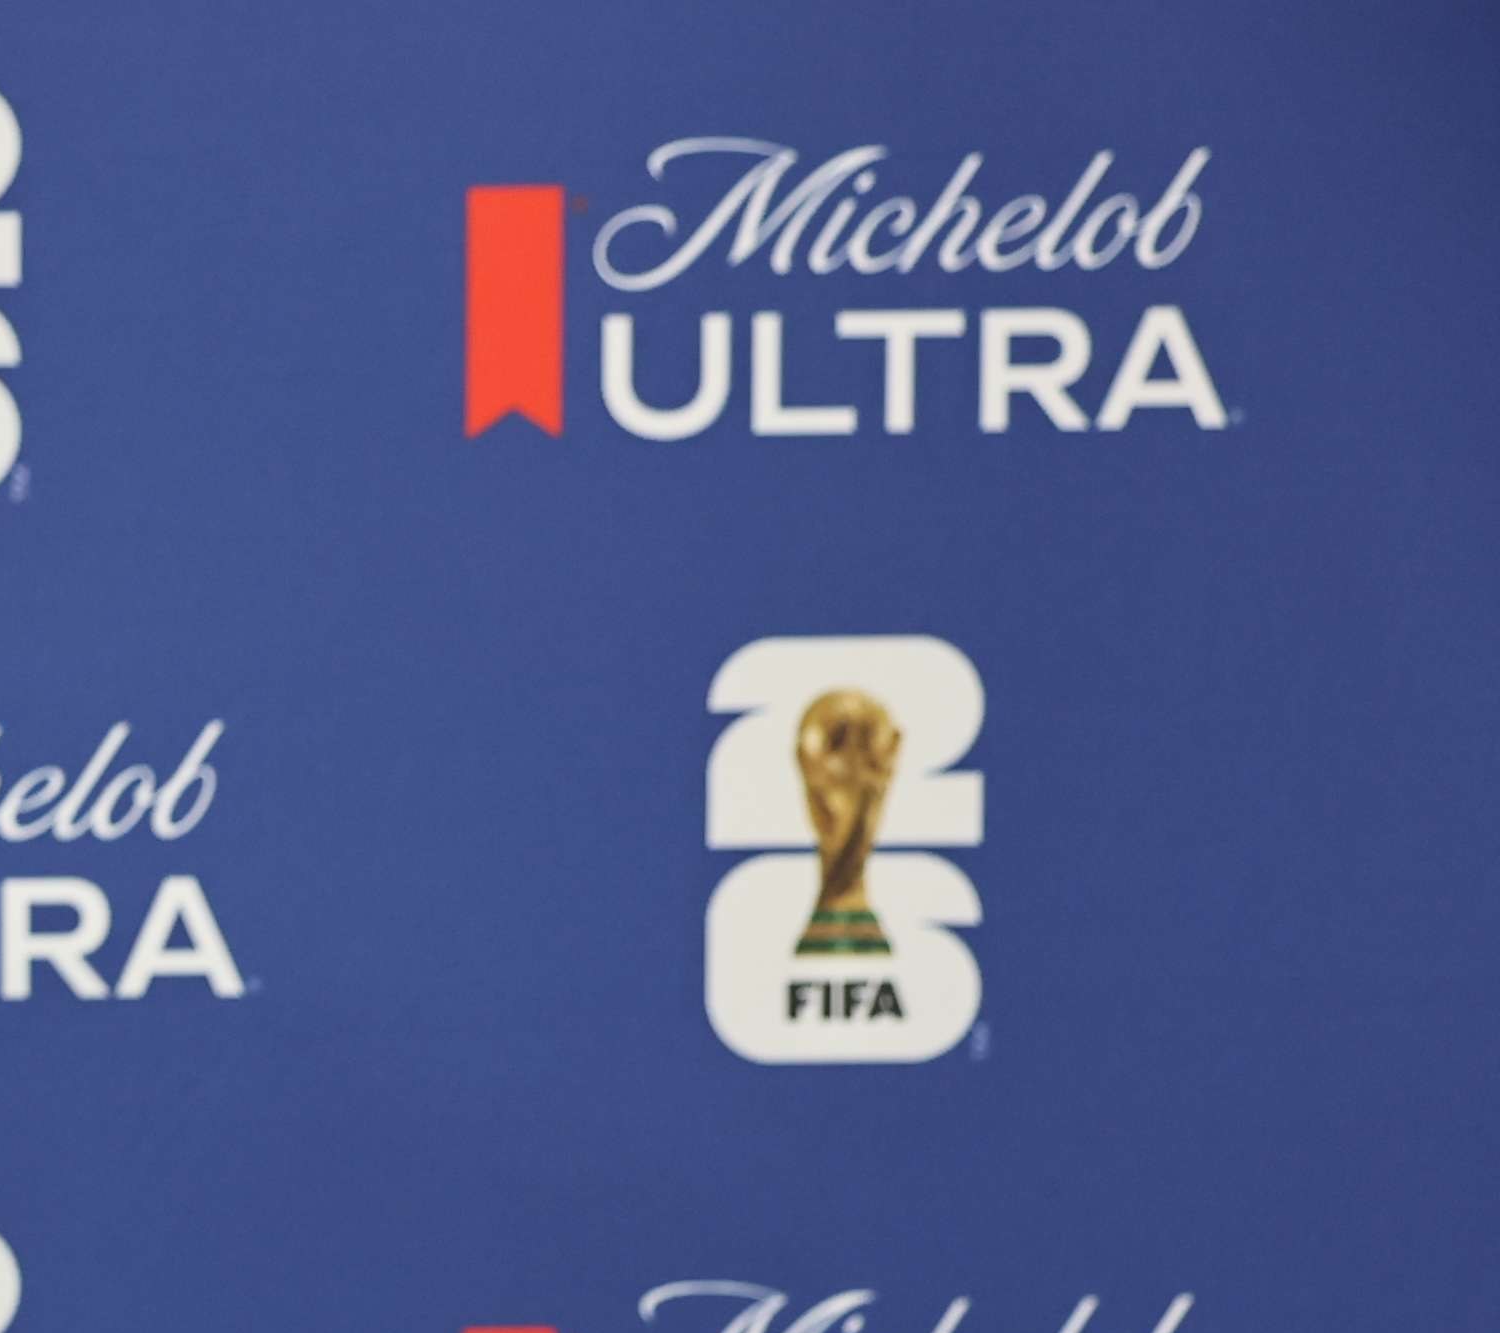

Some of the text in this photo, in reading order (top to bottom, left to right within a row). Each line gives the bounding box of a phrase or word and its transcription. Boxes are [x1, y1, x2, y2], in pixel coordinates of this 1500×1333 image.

[591, 135, 1210, 293] Michelob
[599, 304, 1229, 443] ULTRA
[786, 979, 905, 1022] FIFA
